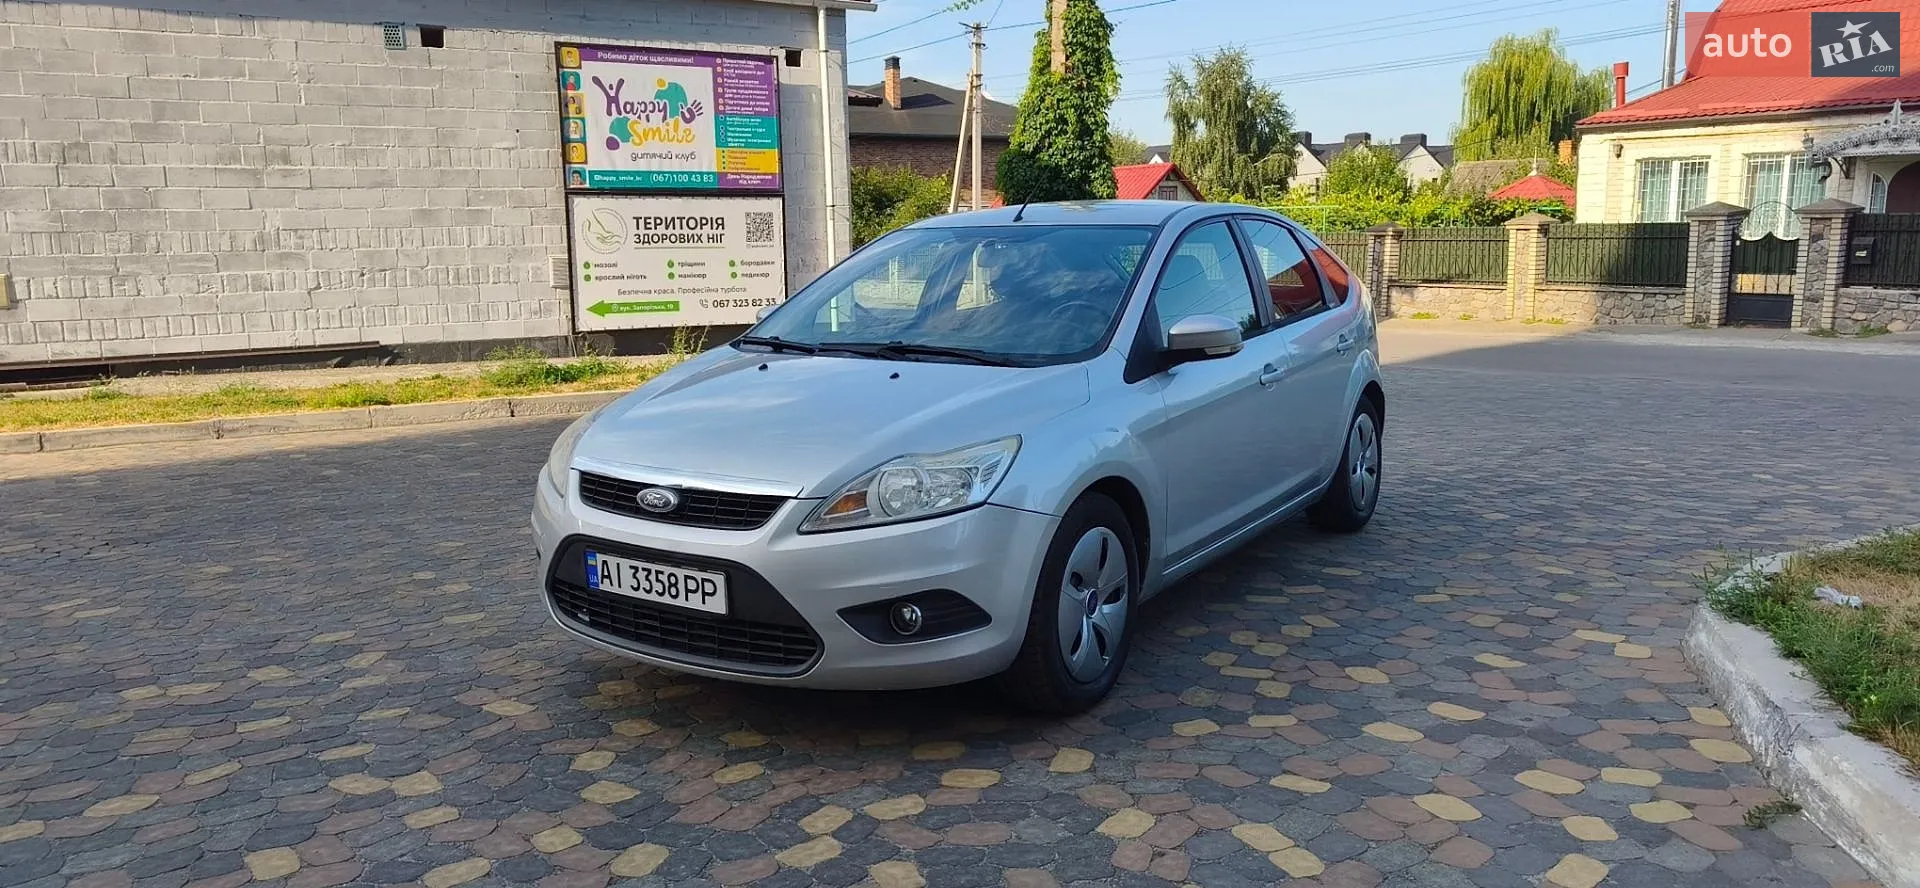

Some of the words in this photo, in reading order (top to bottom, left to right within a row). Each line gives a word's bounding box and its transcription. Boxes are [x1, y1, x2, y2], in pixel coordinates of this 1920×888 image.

[598, 51, 627, 60] Робимо
[628, 54, 648, 62] діток
[649, 55, 694, 64] щасливими!
[591, 75, 669, 123] Happy
[628, 118, 695, 147] Smile
[630, 151, 673, 162] дитячий
[675, 151, 697, 162] клуб
[691, 174, 701, 182] 43
[703, 174, 714, 183] 83
[632, 216, 725, 231] ТЕРИТОРІЯ
[633, 233, 704, 246] ЗДОРОВИХ
[707, 233, 725, 244] НІГ
[712, 300, 730, 308] 067
[732, 299, 749, 307] 323
[751, 298, 763, 306] 82
[765, 298, 777, 306] 33
[643, 493, 666, 507] Ford
[589, 574, 599, 583] UA
[600, 560, 622, 588] AI
[629, 565, 680, 600] 3358
[684, 574, 717, 605] PP
